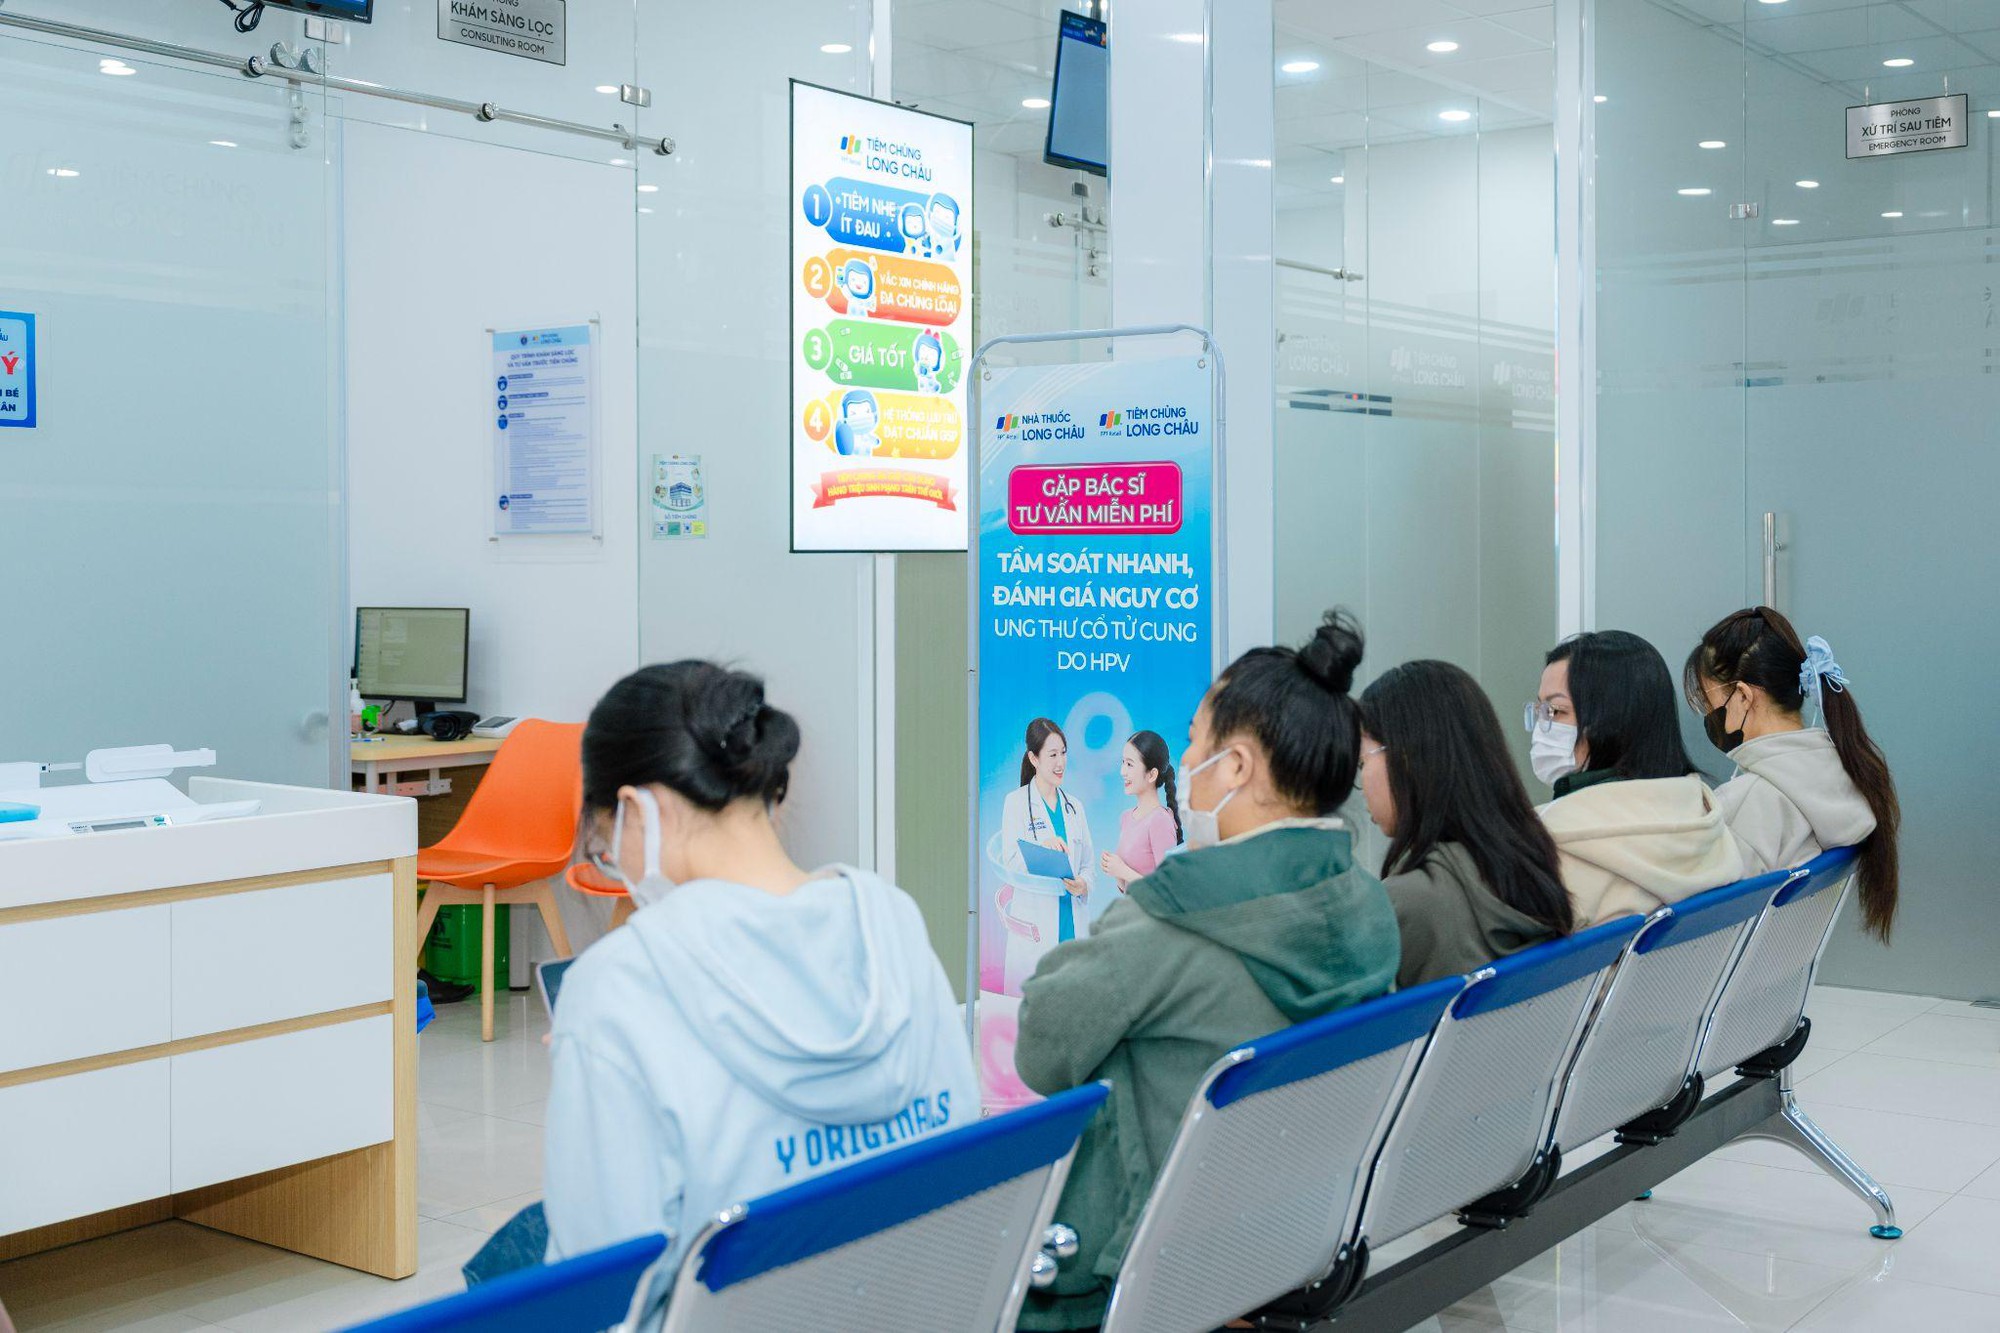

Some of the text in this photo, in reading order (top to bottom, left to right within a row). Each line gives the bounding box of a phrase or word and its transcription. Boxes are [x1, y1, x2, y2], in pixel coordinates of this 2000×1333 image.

[451, 1, 553, 36] KHÁM SÀNG LỌC
[460, 28, 545, 54] CONSULTING ROOM
[1862, 116, 1951, 137] XỬ TRÍ SAU TIÊM
[866, 137, 922, 161] TIÊM CHỦNG
[1868, 135, 1946, 151] EMERGENCY ROOM
[866, 155, 898, 175] LONG
[901, 163, 932, 182] CHÂU
[813, 194, 820, 220] 1
[841, 188, 897, 223] TIÊM NHẸ
[840, 213, 881, 239] ÍT ĐAU
[810, 264, 823, 290] 2
[880, 291, 957, 318] ĐA CHỦNG LOẠI
[810, 336, 822, 361] 3
[849, 342, 907, 369] GIÁ TỐT
[1, 351, 19, 375] Ý
[5, 388, 20, 398] BÉ
[0, 402, 16, 412] ÂN
[809, 406, 823, 433] 4
[1021, 409, 1071, 425] NHÀ THUỐC
[1126, 404, 1187, 420] TIÊM CHỦNG
[1022, 428, 1053, 441] LONG
[1055, 424, 1085, 440] CHÂU
[1126, 418, 1199, 438] LONG CHÂU
[1042, 472, 1147, 500] GẶP BÁC SĨ
[1016, 497, 1174, 524] TƯ VẤN MIỄN PHÍ
[997, 545, 1194, 579] TẦM SOÁT NHANH,
[992, 580, 1199, 610] ĐÁNH GIÁ NGUY CƠ
[994, 613, 1197, 643] UNG THƯ CỔ TỬ CUNG
[1057, 651, 1131, 673] DO HPV
[805, 1090, 950, 1167] ORIGINAS
